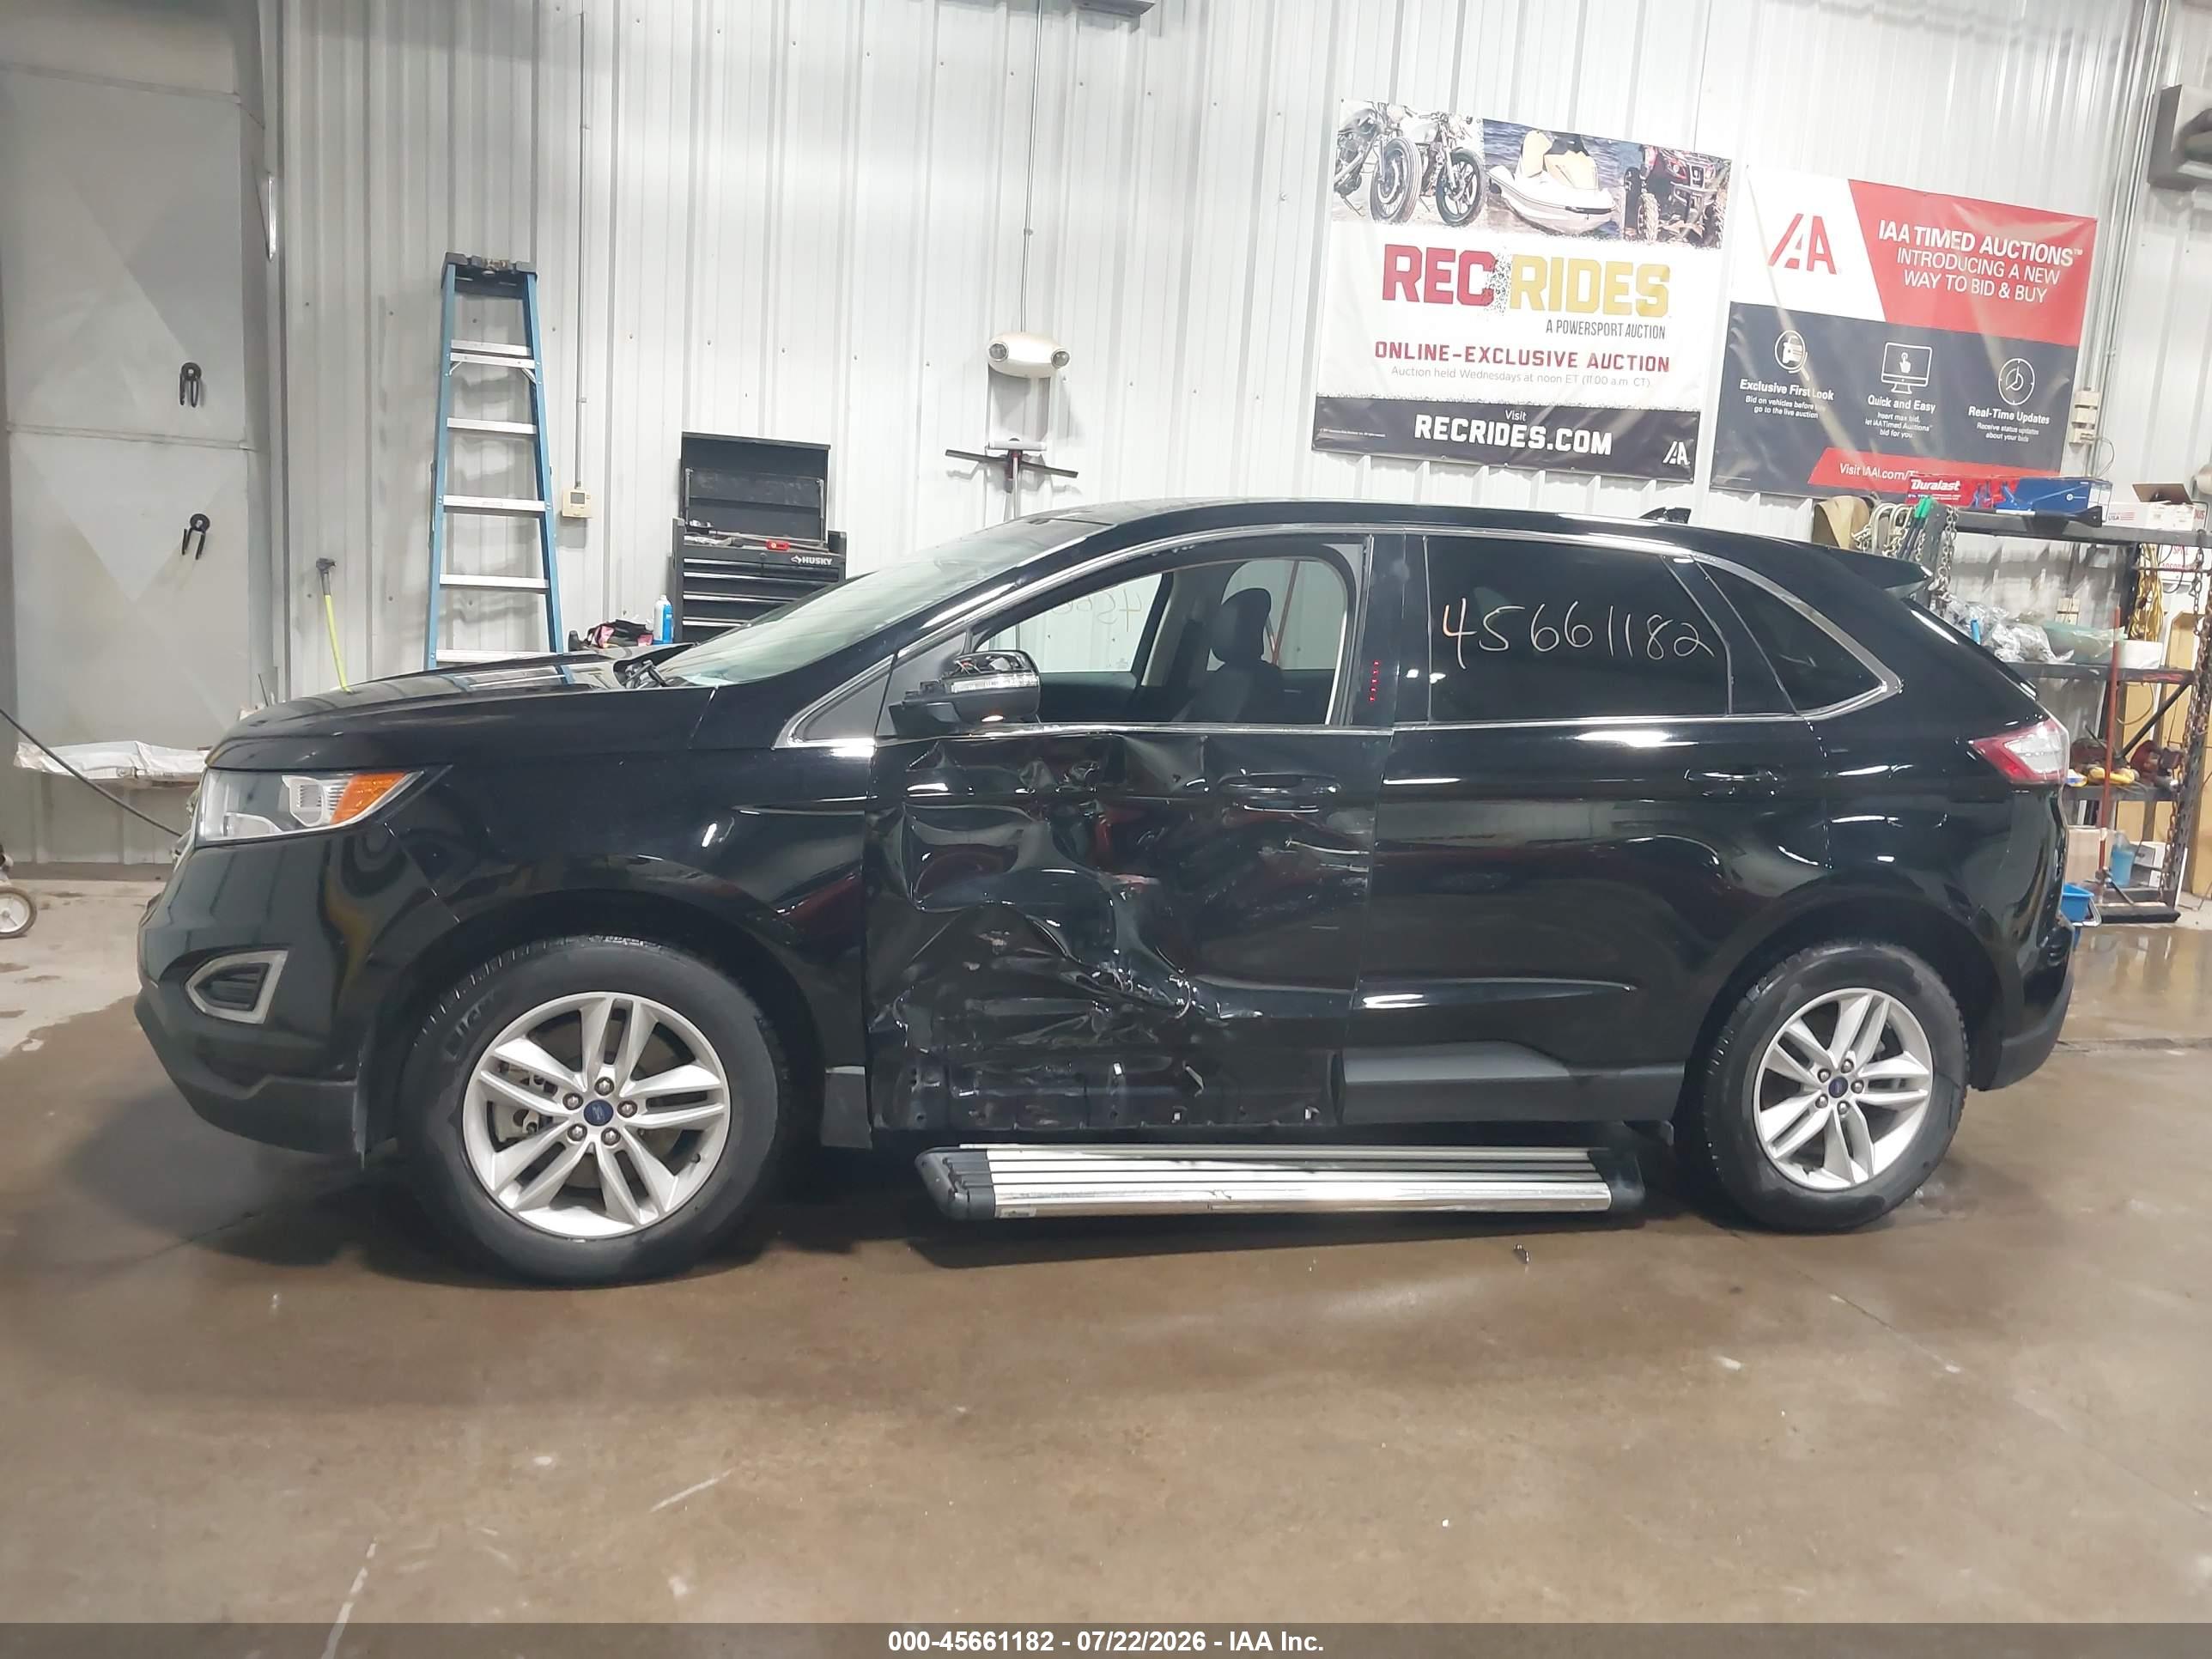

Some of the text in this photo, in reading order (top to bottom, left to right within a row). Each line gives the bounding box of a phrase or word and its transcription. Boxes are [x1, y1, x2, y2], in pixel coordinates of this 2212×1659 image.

[1878, 219, 1910, 244] IAA
[1914, 225, 1975, 252] TIMED
[1897, 246, 2061, 285] INTRODUCING A NEW
[1382, 244, 1670, 318] REC RIDES
[1904, 269, 2048, 302] WAY TO BID & BUY
[1546, 319, 1666, 340] A POWERSPORT AUCTION
[1375, 341, 1669, 373] ONLINE-EXCLUSIVE AUCTION
[1391, 366, 1431, 377] Auction
[1434, 368, 1456, 378] held
[1460, 369, 1521, 383] Wednesdays
[1537, 374, 1562, 384] noon
[1565, 374, 1579, 383] ET
[1633, 378, 1650, 387] CT)
[1740, 378, 1835, 400] Exclusive First Look
[1745, 395, 1757, 404] Bid
[1868, 394, 1936, 414] Quick and Easy
[1968, 405, 2050, 424] Real-Time Updates
[1504, 410, 1527, 422] Visit
[1414, 414, 1613, 455] RECRIDES.COM
[1839, 463, 1861, 477] Visit
[1911, 478, 1962, 491] Duralast
[801, 556, 833, 566] HUSKY
[1443, 598, 1716, 670] 45661182
